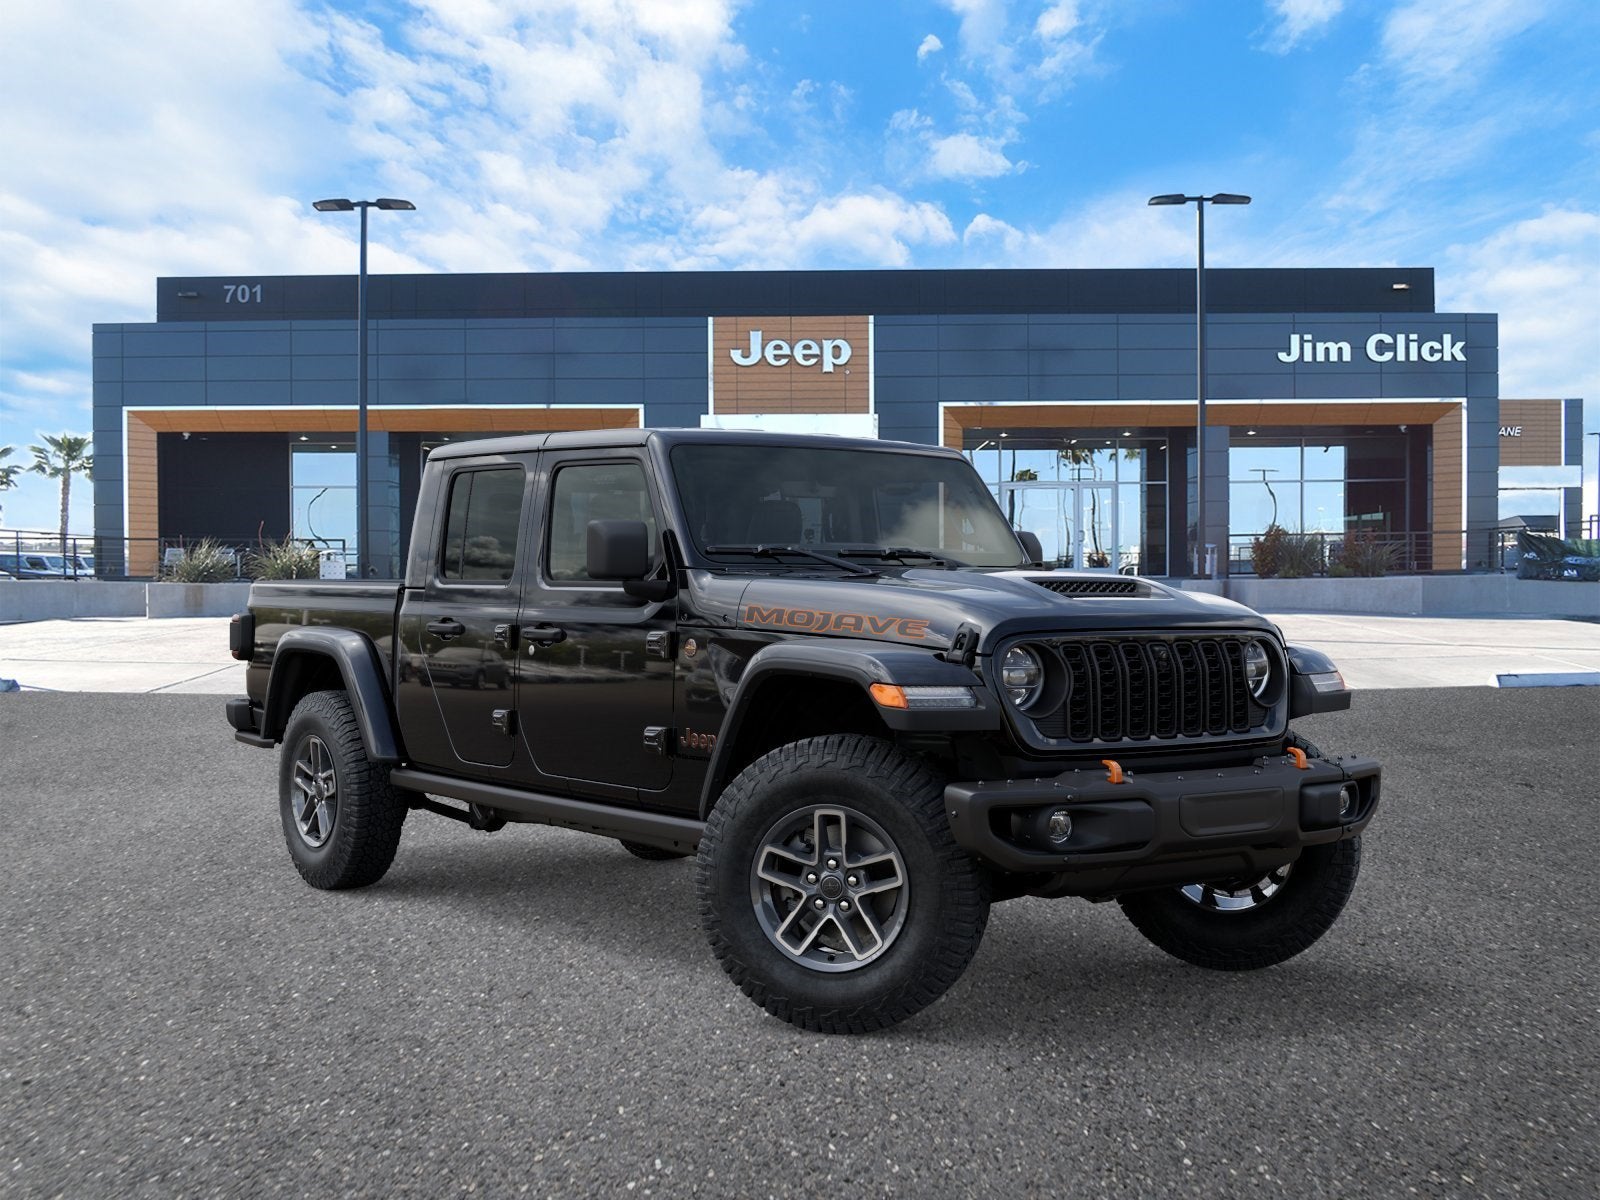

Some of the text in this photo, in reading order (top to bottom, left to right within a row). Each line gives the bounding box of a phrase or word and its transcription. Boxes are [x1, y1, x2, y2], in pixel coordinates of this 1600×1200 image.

[223, 284, 262, 304] 701
[730, 330, 852, 373] Jeep
[1277, 332, 1467, 363] Jim Click
[744, 605, 929, 639] MOJAVE
[680, 727, 717, 753] Jeep
